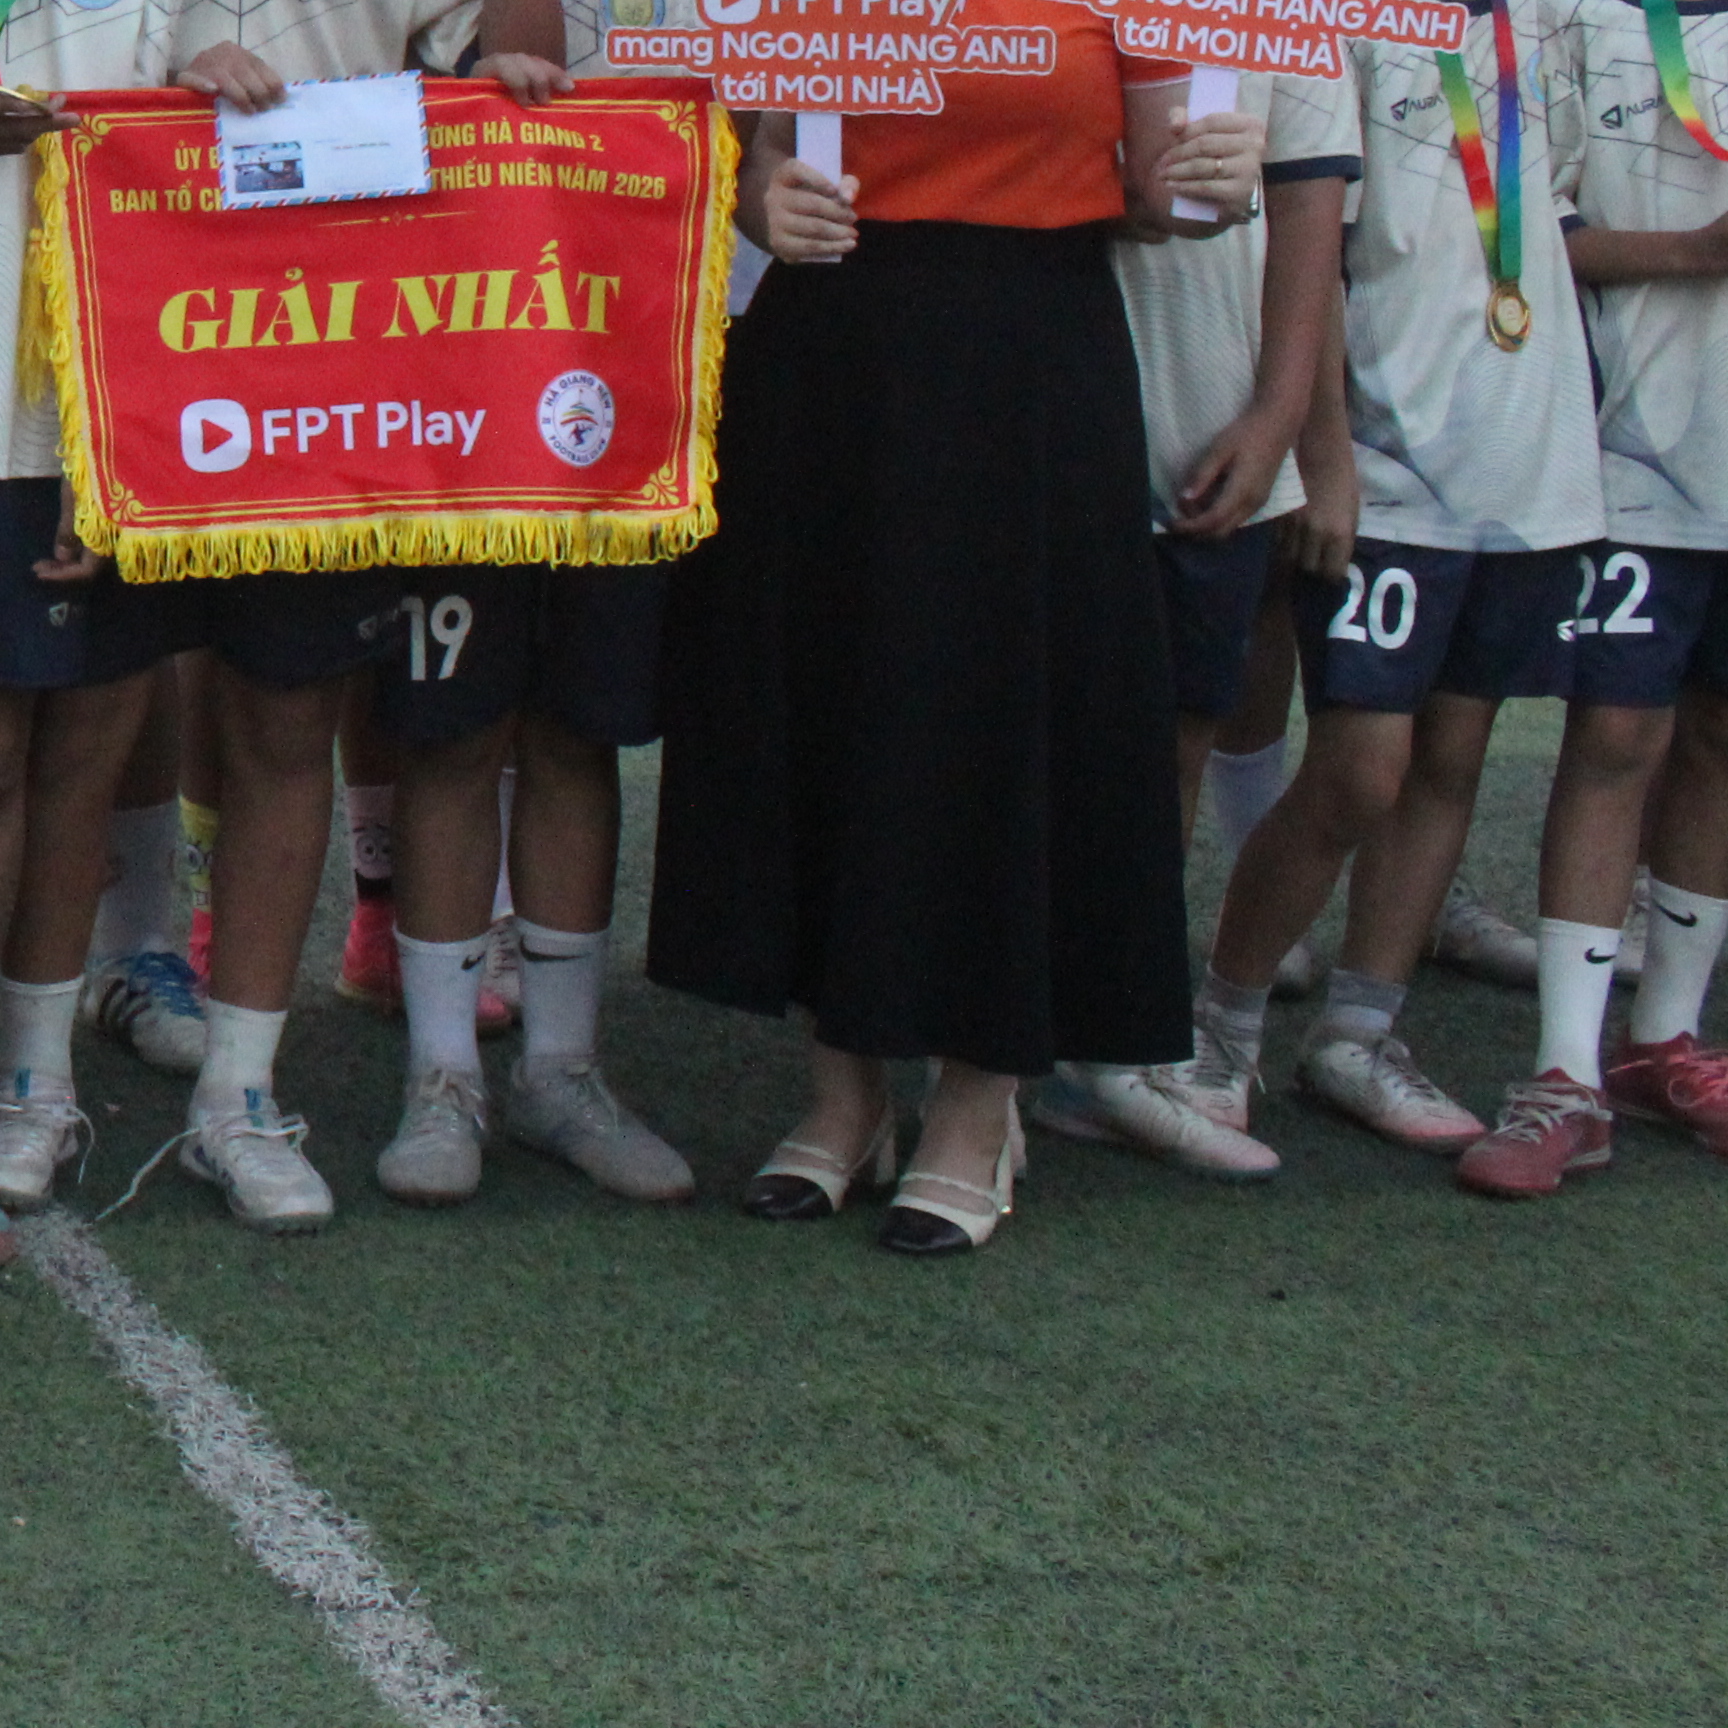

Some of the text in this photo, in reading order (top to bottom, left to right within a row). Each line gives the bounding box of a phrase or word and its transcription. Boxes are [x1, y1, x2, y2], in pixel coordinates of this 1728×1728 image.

[613, 30, 1046, 69] mang NGOẠI HẠNG ANH
[1123, 17, 1172, 50] tới
[1254, 32, 1336, 71] NHÀ
[1371, 1, 1458, 43] ANH
[721, 71, 768, 102] tới
[852, 68, 934, 104] NHÀ
[174, 139, 202, 171] ỦY
[482, 117, 514, 144] HÀ
[519, 121, 586, 149] GIANG
[589, 134, 604, 152] 2
[109, 188, 158, 213] BAN
[164, 179, 192, 211] TỔ
[499, 157, 553, 187] NIÊN
[557, 162, 608, 192] NĂM
[612, 172, 667, 200] 2026
[158, 239, 621, 353] GIẢI NHẤT
[262, 400, 487, 457] FPT Play
[1327, 563, 1418, 650] 20
[401, 594, 475, 682] 19
